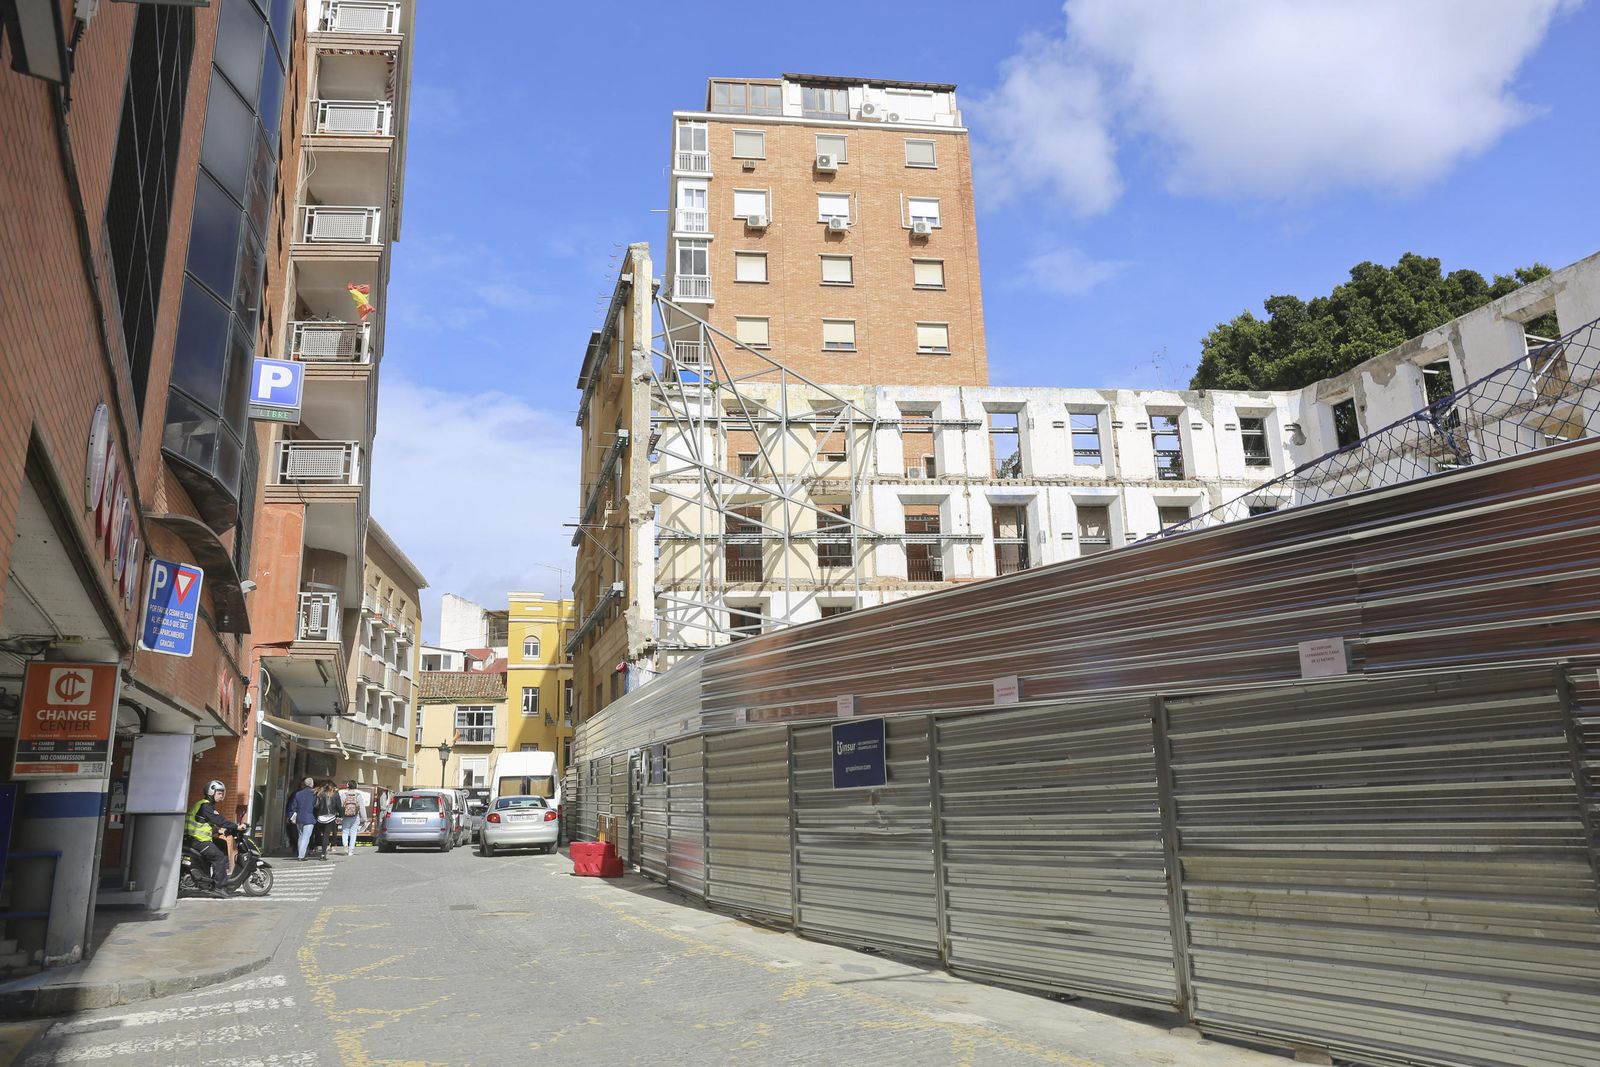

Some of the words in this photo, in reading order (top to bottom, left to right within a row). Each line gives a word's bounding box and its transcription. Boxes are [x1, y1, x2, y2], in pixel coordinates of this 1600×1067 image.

[258, 364, 293, 399] P
[260, 410, 289, 419] LIBRE
[152, 564, 168, 600] P
[36, 709, 97, 721] CHANGE
[40, 720, 90, 732] CENTER
